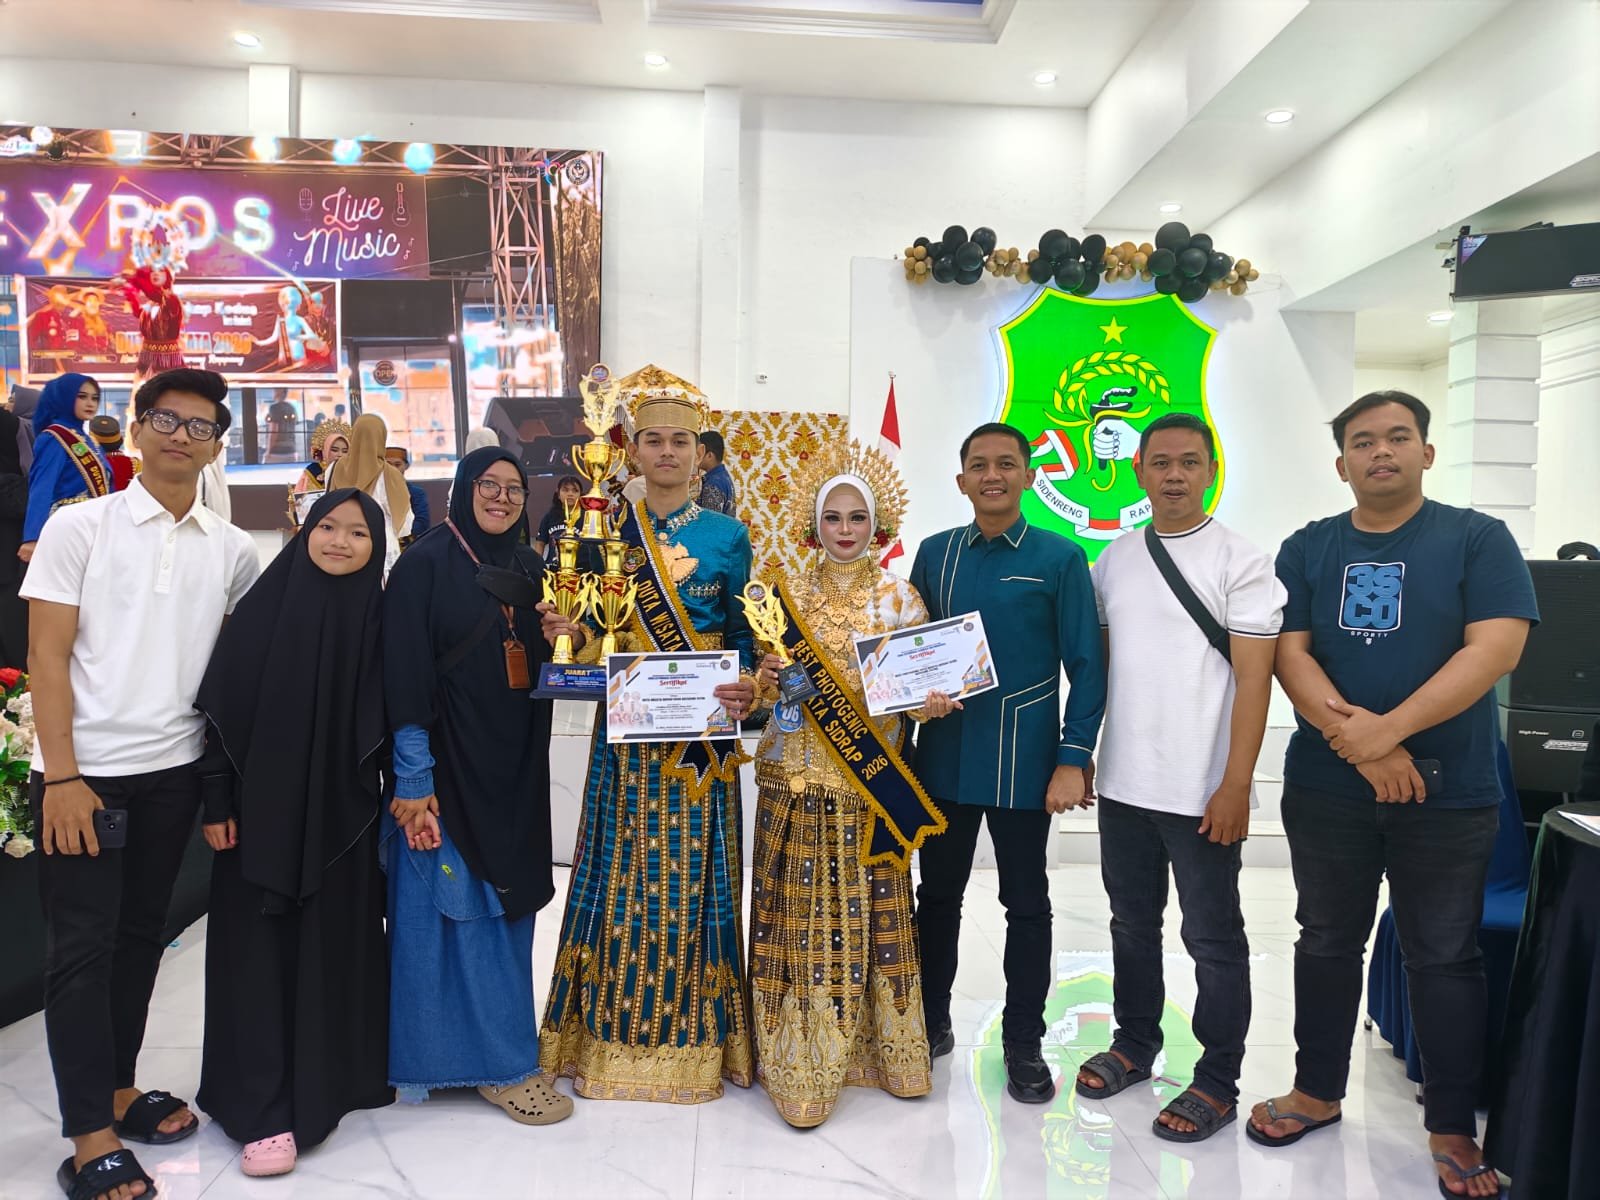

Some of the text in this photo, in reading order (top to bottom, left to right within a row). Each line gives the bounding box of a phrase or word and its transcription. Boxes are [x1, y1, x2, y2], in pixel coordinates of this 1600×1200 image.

[0, 183, 274, 262] XPOS
[322, 187, 383, 231] Live
[294, 227, 401, 271] Music
[1036, 479, 1084, 519] SIDENRENG
[638, 579, 662, 613] DUTA
[650, 611, 685, 652] WISATA
[794, 640, 818, 669] BEST
[812, 669, 869, 740] PHOTOGENIC
[807, 696, 889, 781] ATA SIDRAP 2026
